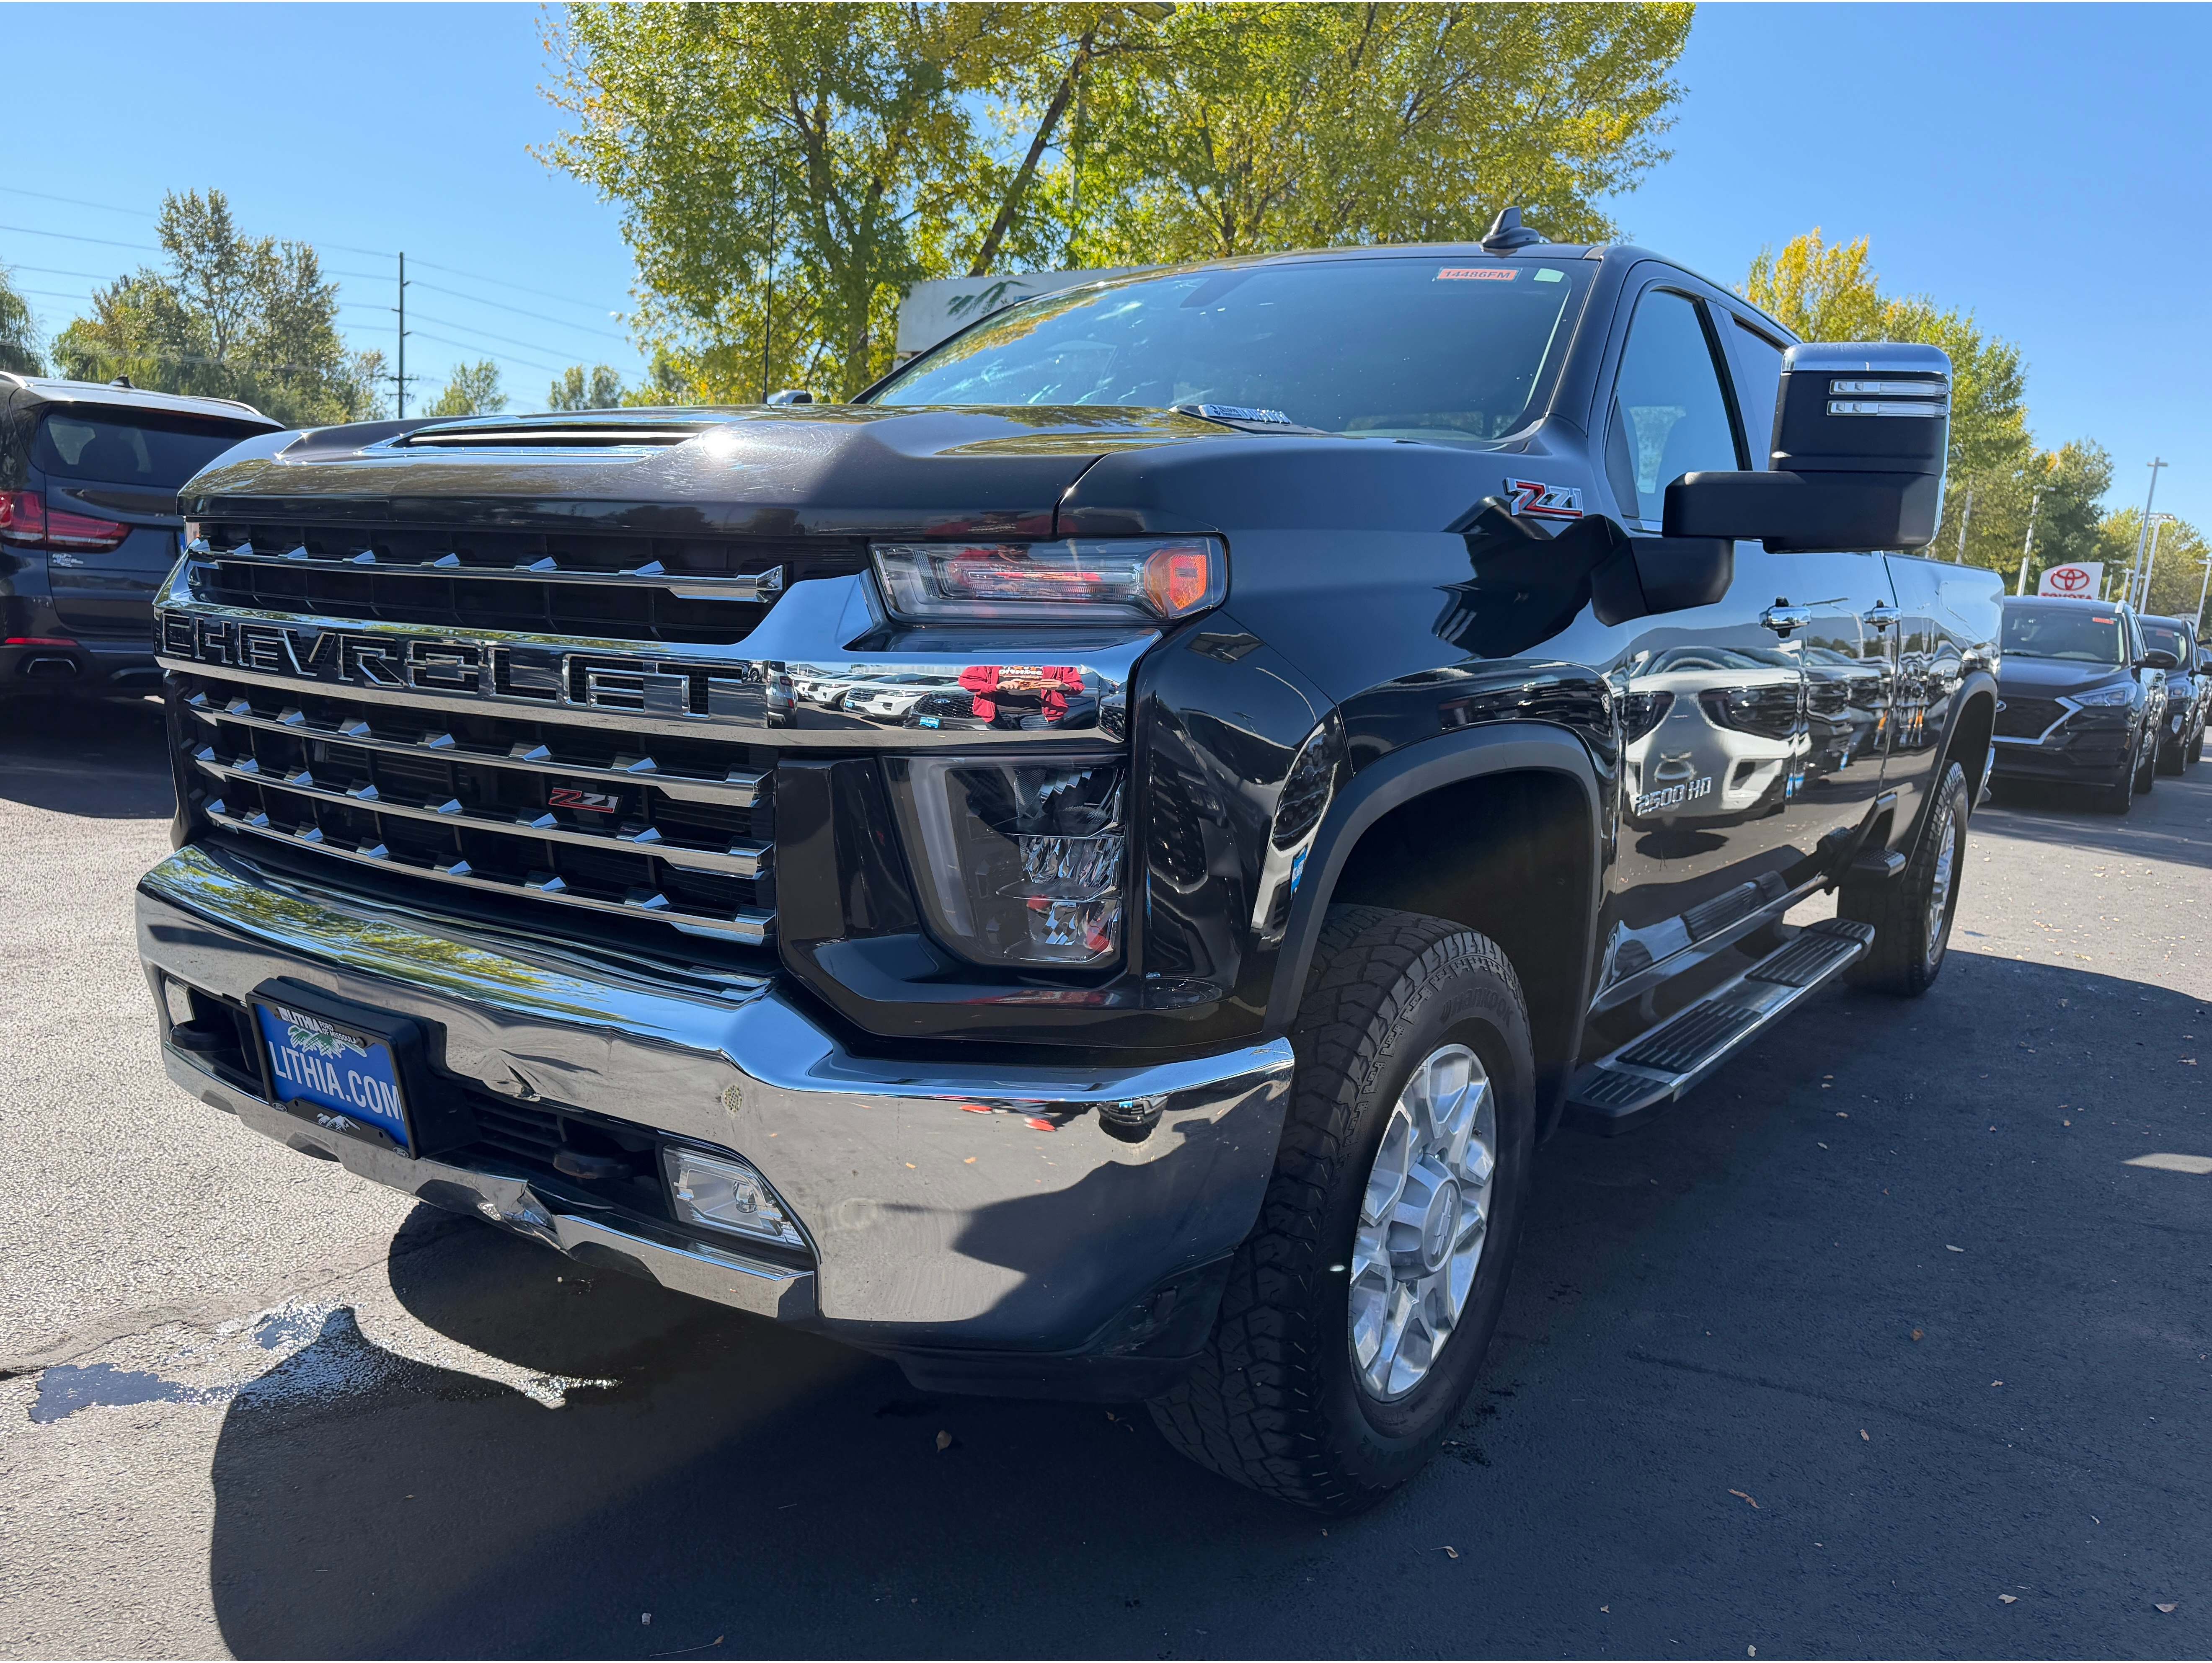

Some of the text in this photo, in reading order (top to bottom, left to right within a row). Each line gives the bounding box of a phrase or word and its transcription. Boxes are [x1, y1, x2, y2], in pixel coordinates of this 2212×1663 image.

[1503, 477, 1584, 519] Z71
[162, 612, 744, 719] CHEVROLET
[548, 788, 619, 813] Z71
[1636, 777, 1711, 816] 2500 HD
[287, 1009, 323, 1033] LITHIA
[318, 1021, 334, 1032] FORD
[269, 1041, 404, 1122] LITHIA.COM
